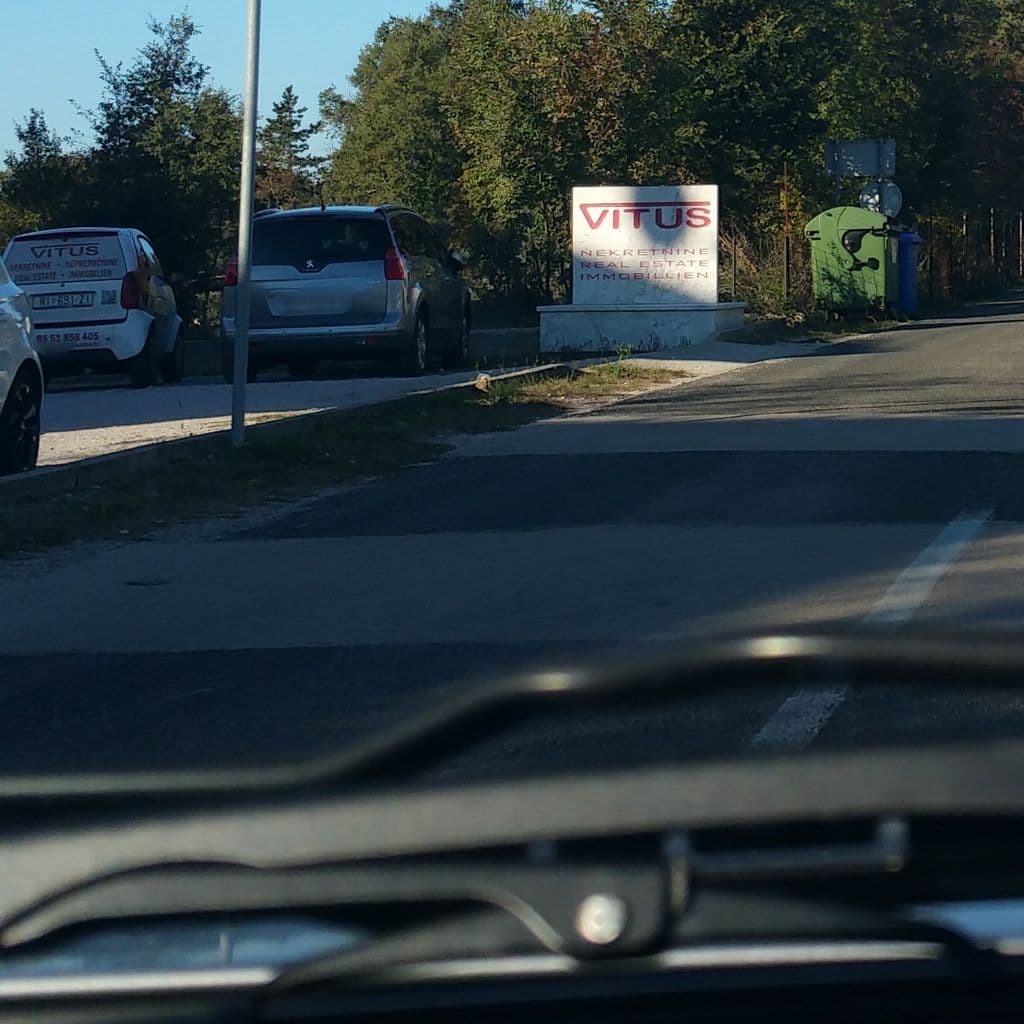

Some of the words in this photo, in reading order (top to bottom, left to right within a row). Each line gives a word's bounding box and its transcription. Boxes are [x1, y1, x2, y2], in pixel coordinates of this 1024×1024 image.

[579, 201, 711, 230] VITUS
[30, 242, 100, 259] VITUS
[580, 248, 709, 257] NEKRETNINE
[580, 261, 630, 269] REAL
[639, 259, 709, 268] ESTATE
